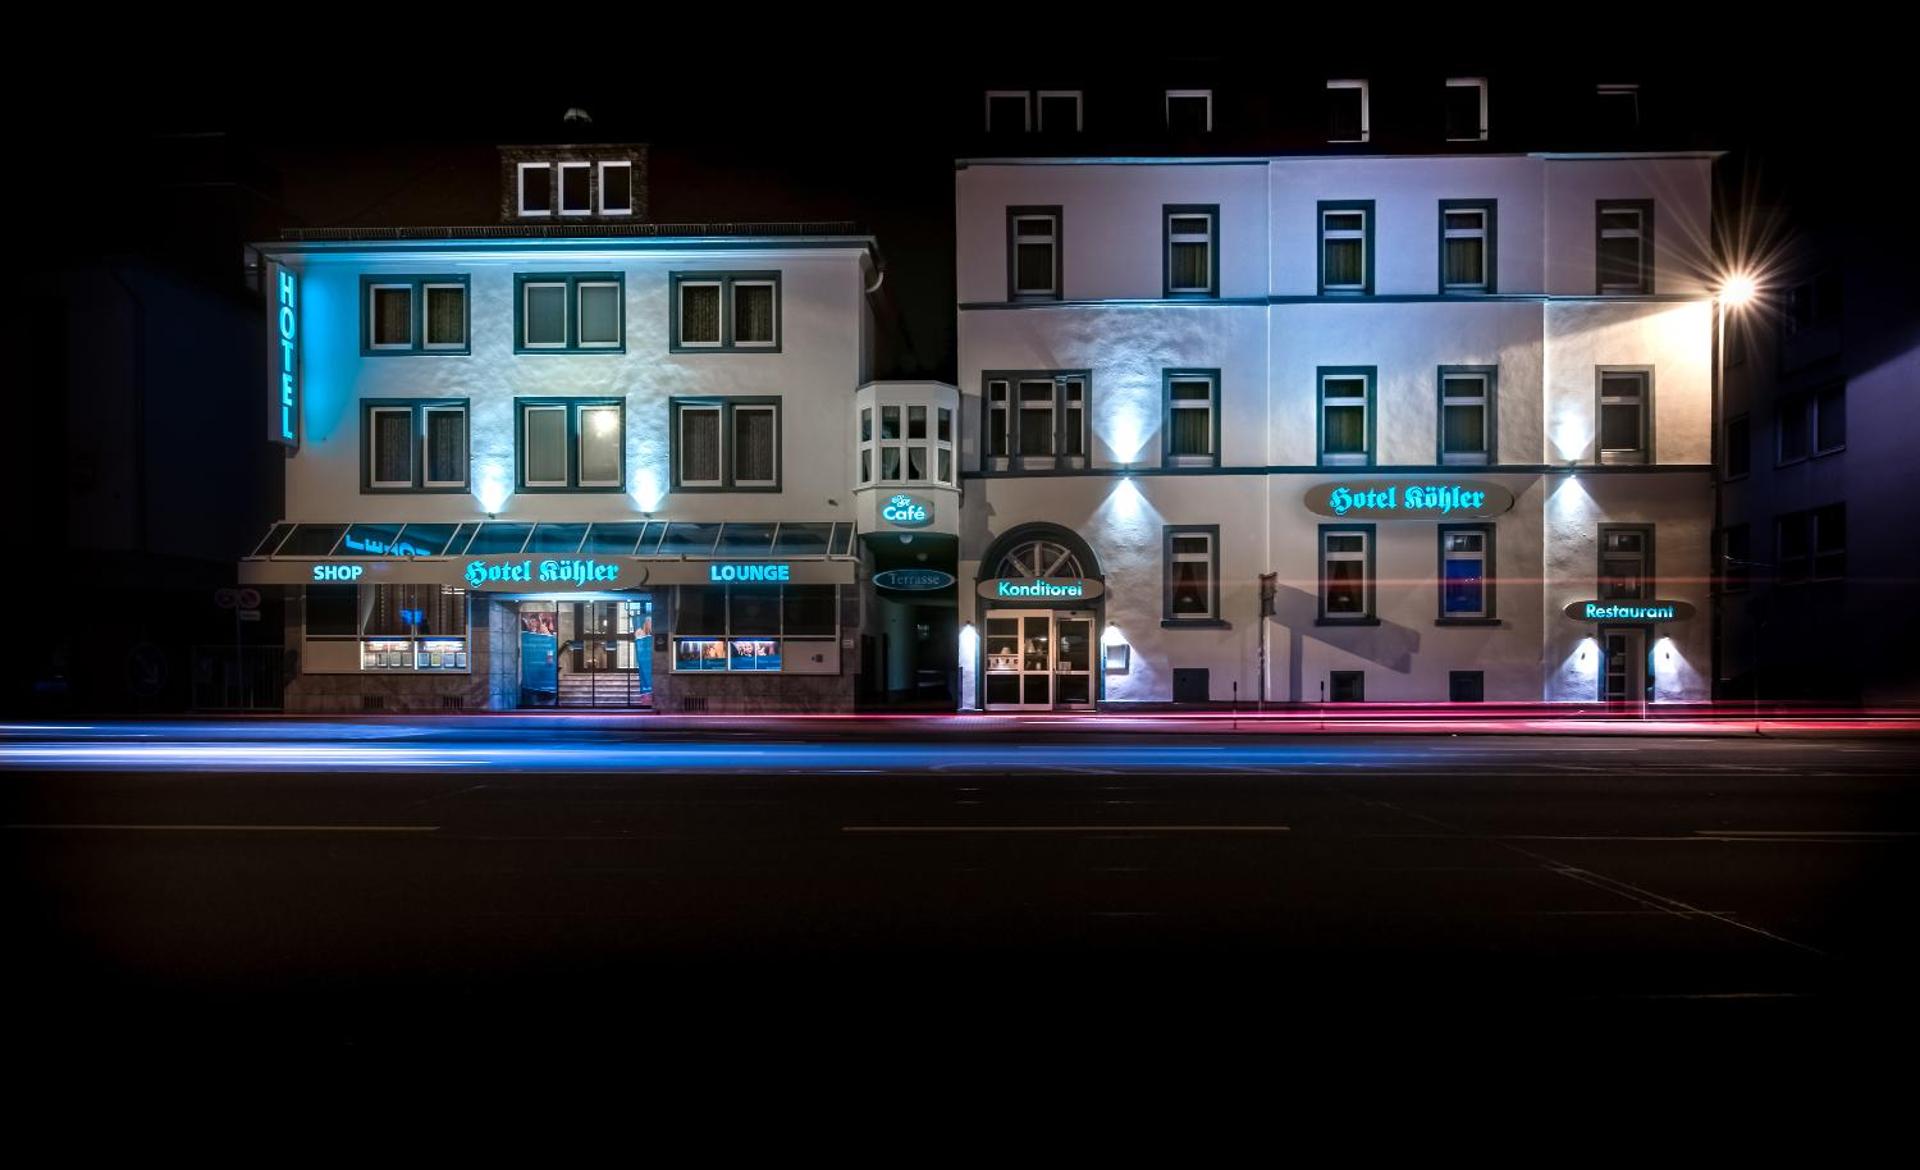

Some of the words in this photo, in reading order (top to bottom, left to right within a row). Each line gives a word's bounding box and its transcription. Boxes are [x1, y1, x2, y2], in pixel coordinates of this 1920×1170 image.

[279, 271, 295, 440] HOTEL
[1329, 486, 1397, 516] Hotel
[1405, 486, 1485, 514] Köhler
[883, 506, 925, 521] Café
[313, 565, 363, 580] SHOP
[464, 560, 532, 588] Hotel
[539, 560, 619, 587] Köhler
[711, 565, 790, 581] LOUNGE
[888, 573, 941, 585] Terrasse
[998, 580, 1083, 596] Konditorei
[1586, 603, 1674, 618] Restaurant
